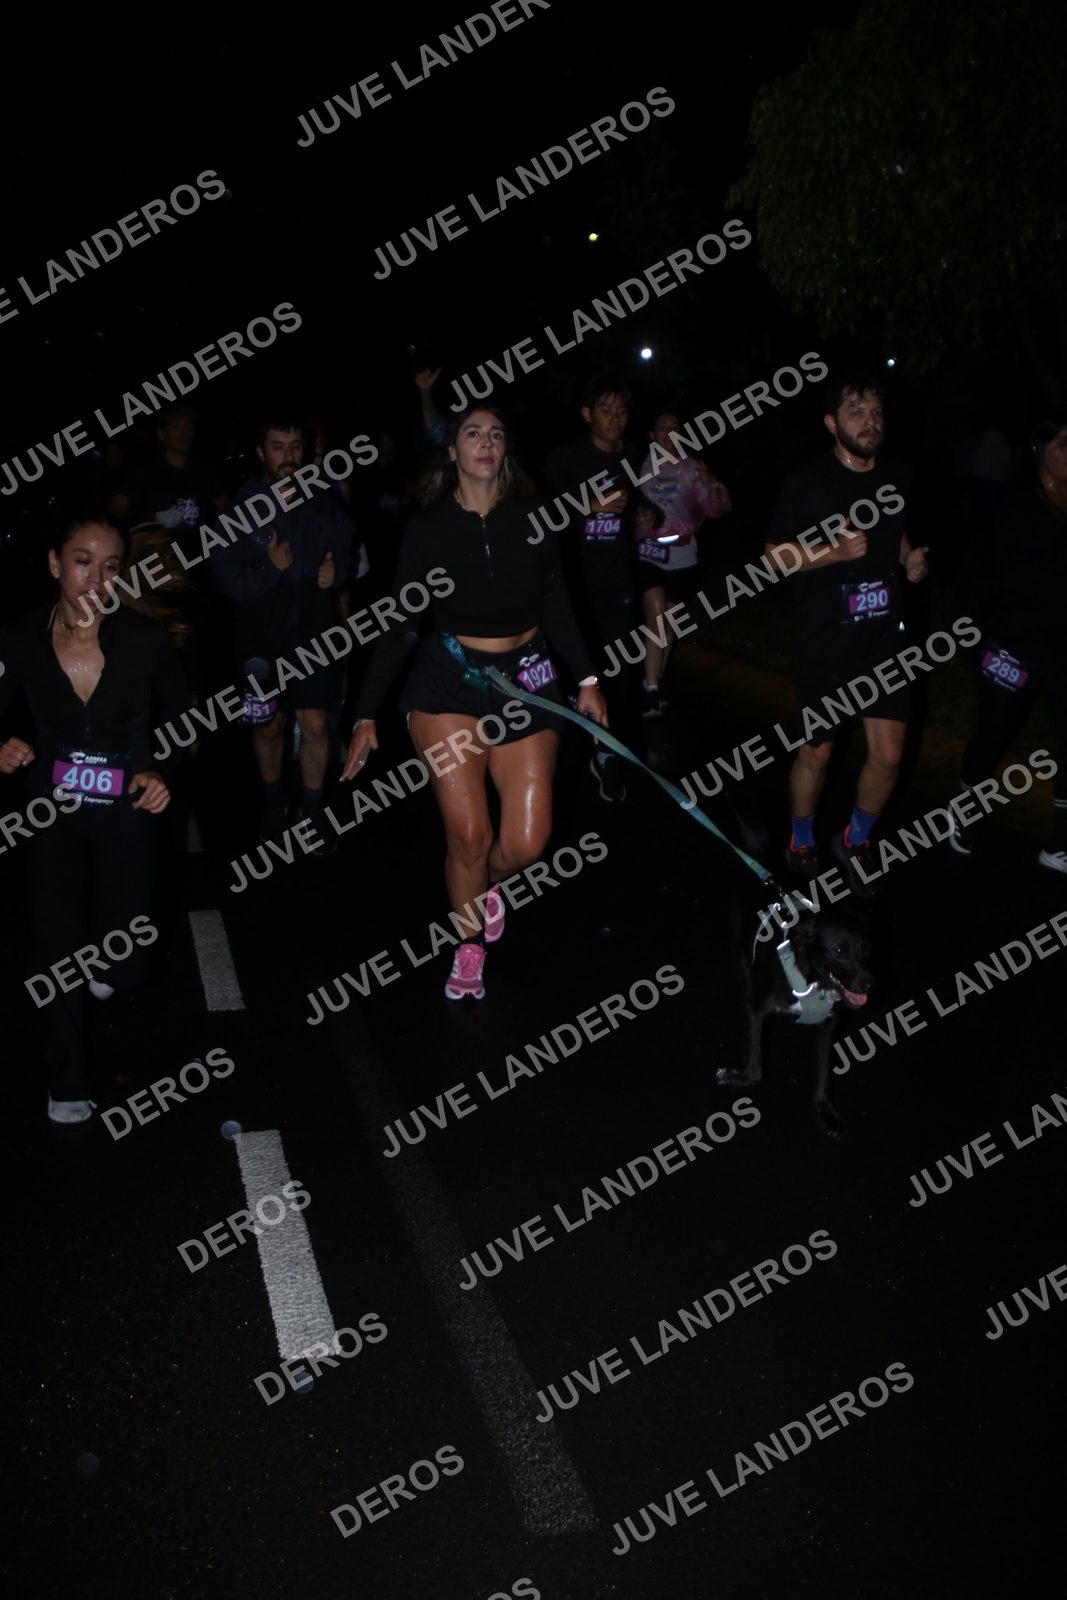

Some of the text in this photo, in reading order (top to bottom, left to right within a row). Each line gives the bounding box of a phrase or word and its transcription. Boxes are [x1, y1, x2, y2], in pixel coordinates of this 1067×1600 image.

[586, 519, 621, 534] 1704
[855, 589, 889, 612] 290
[523, 658, 555, 690] 1927
[987, 657, 1021, 684] 289
[62, 766, 113, 794] 406
